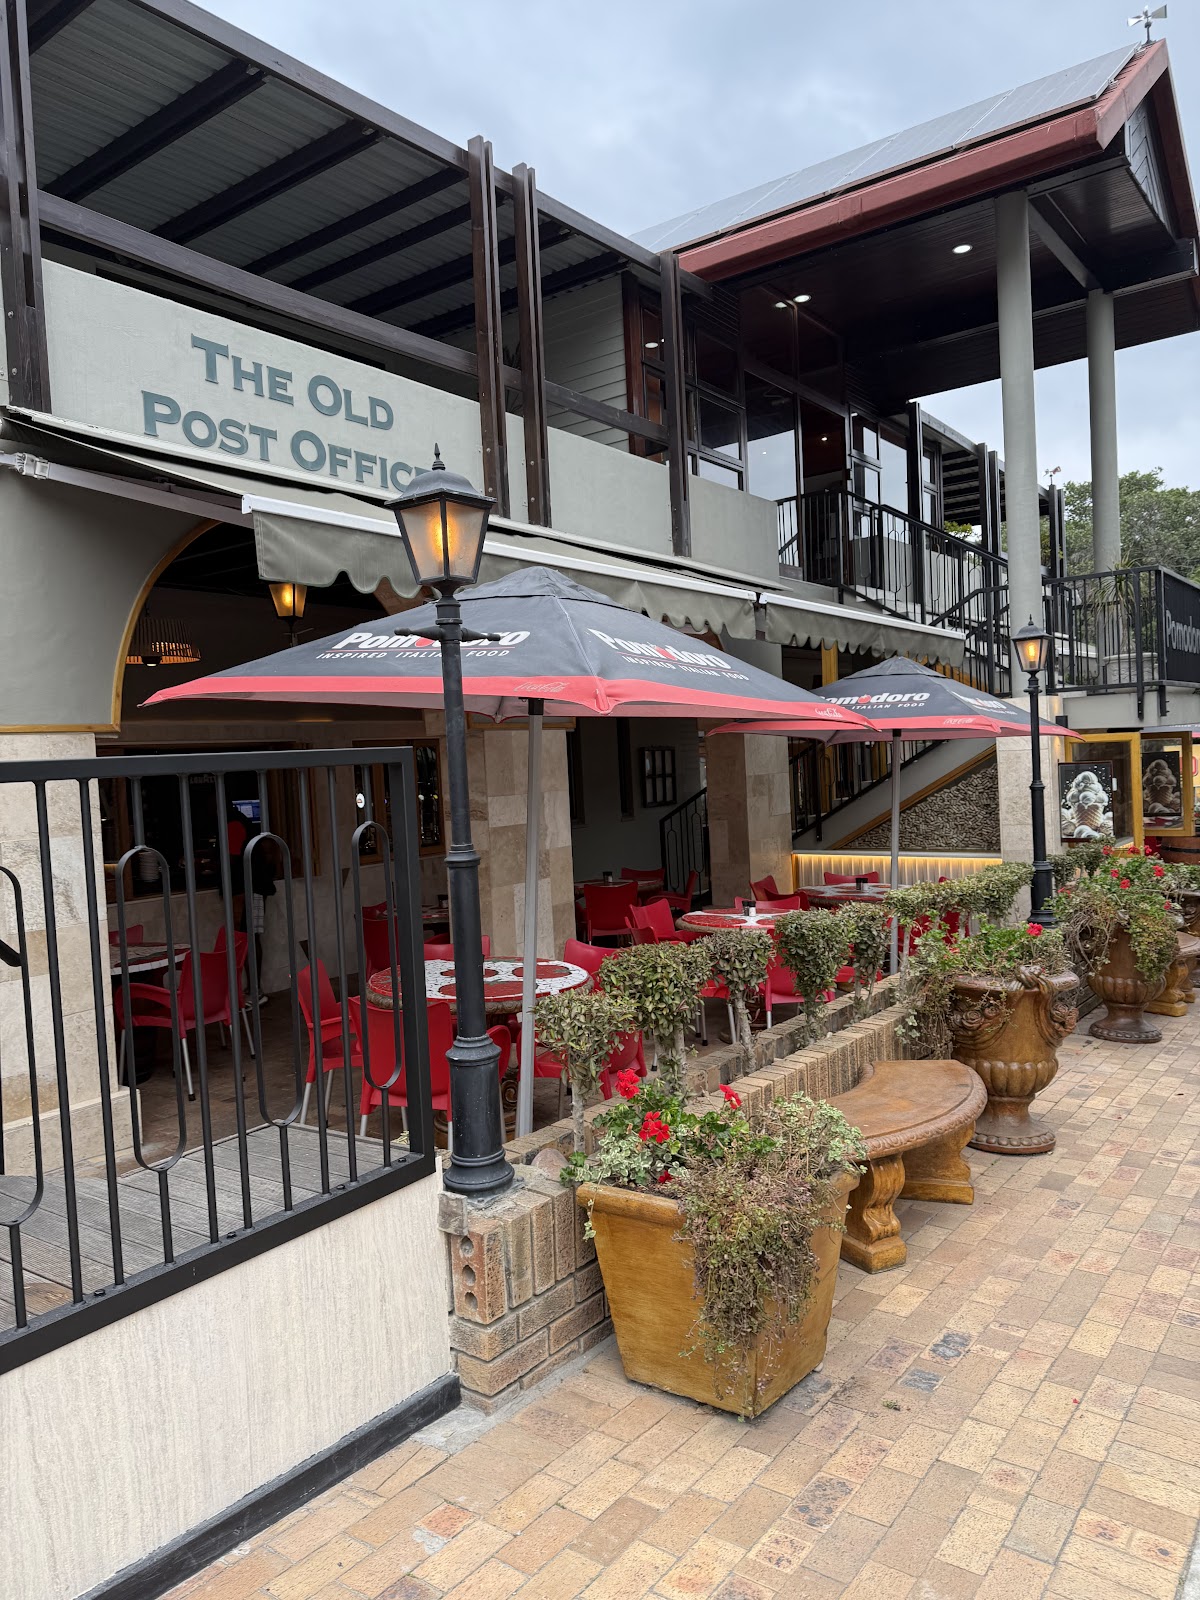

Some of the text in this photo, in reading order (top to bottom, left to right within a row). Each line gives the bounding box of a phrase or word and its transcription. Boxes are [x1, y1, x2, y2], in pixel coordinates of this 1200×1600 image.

[190, 332, 394, 431] THE OLD
[141, 389, 432, 493] POST OFFIC
[316, 649, 510, 660] INSPIRED ITALIA FOOD
[820, 692, 931, 705] omodoro
